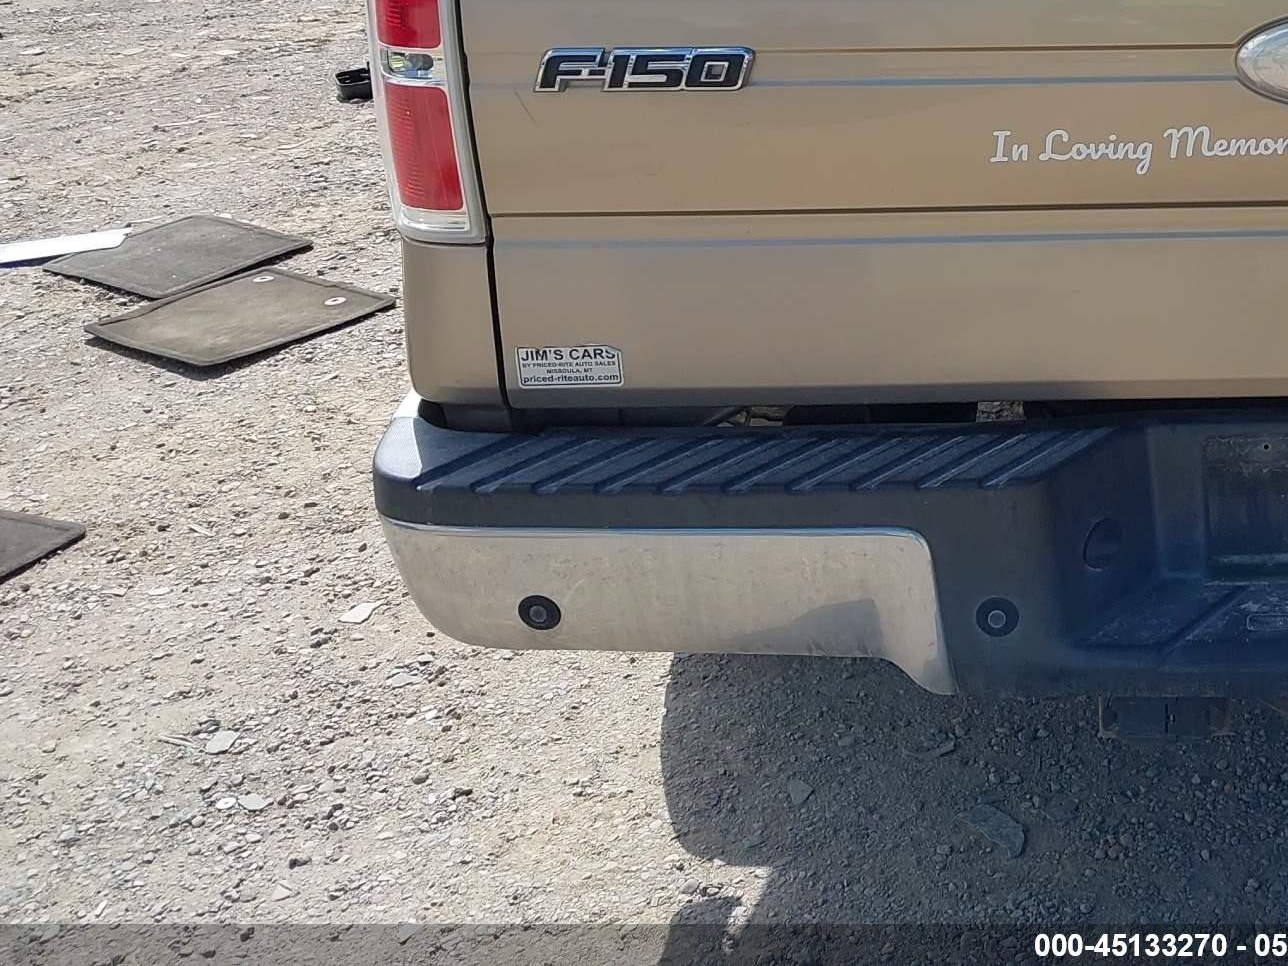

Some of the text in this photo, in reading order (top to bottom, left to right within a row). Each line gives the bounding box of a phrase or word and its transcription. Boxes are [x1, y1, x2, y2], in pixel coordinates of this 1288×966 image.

[534, 47, 755, 92] F-150
[990, 130, 1029, 162] In
[1039, 129, 1152, 175] Loving
[521, 348, 616, 361] JIM'S CARS
[523, 374, 619, 383] priced-riteauto.com
